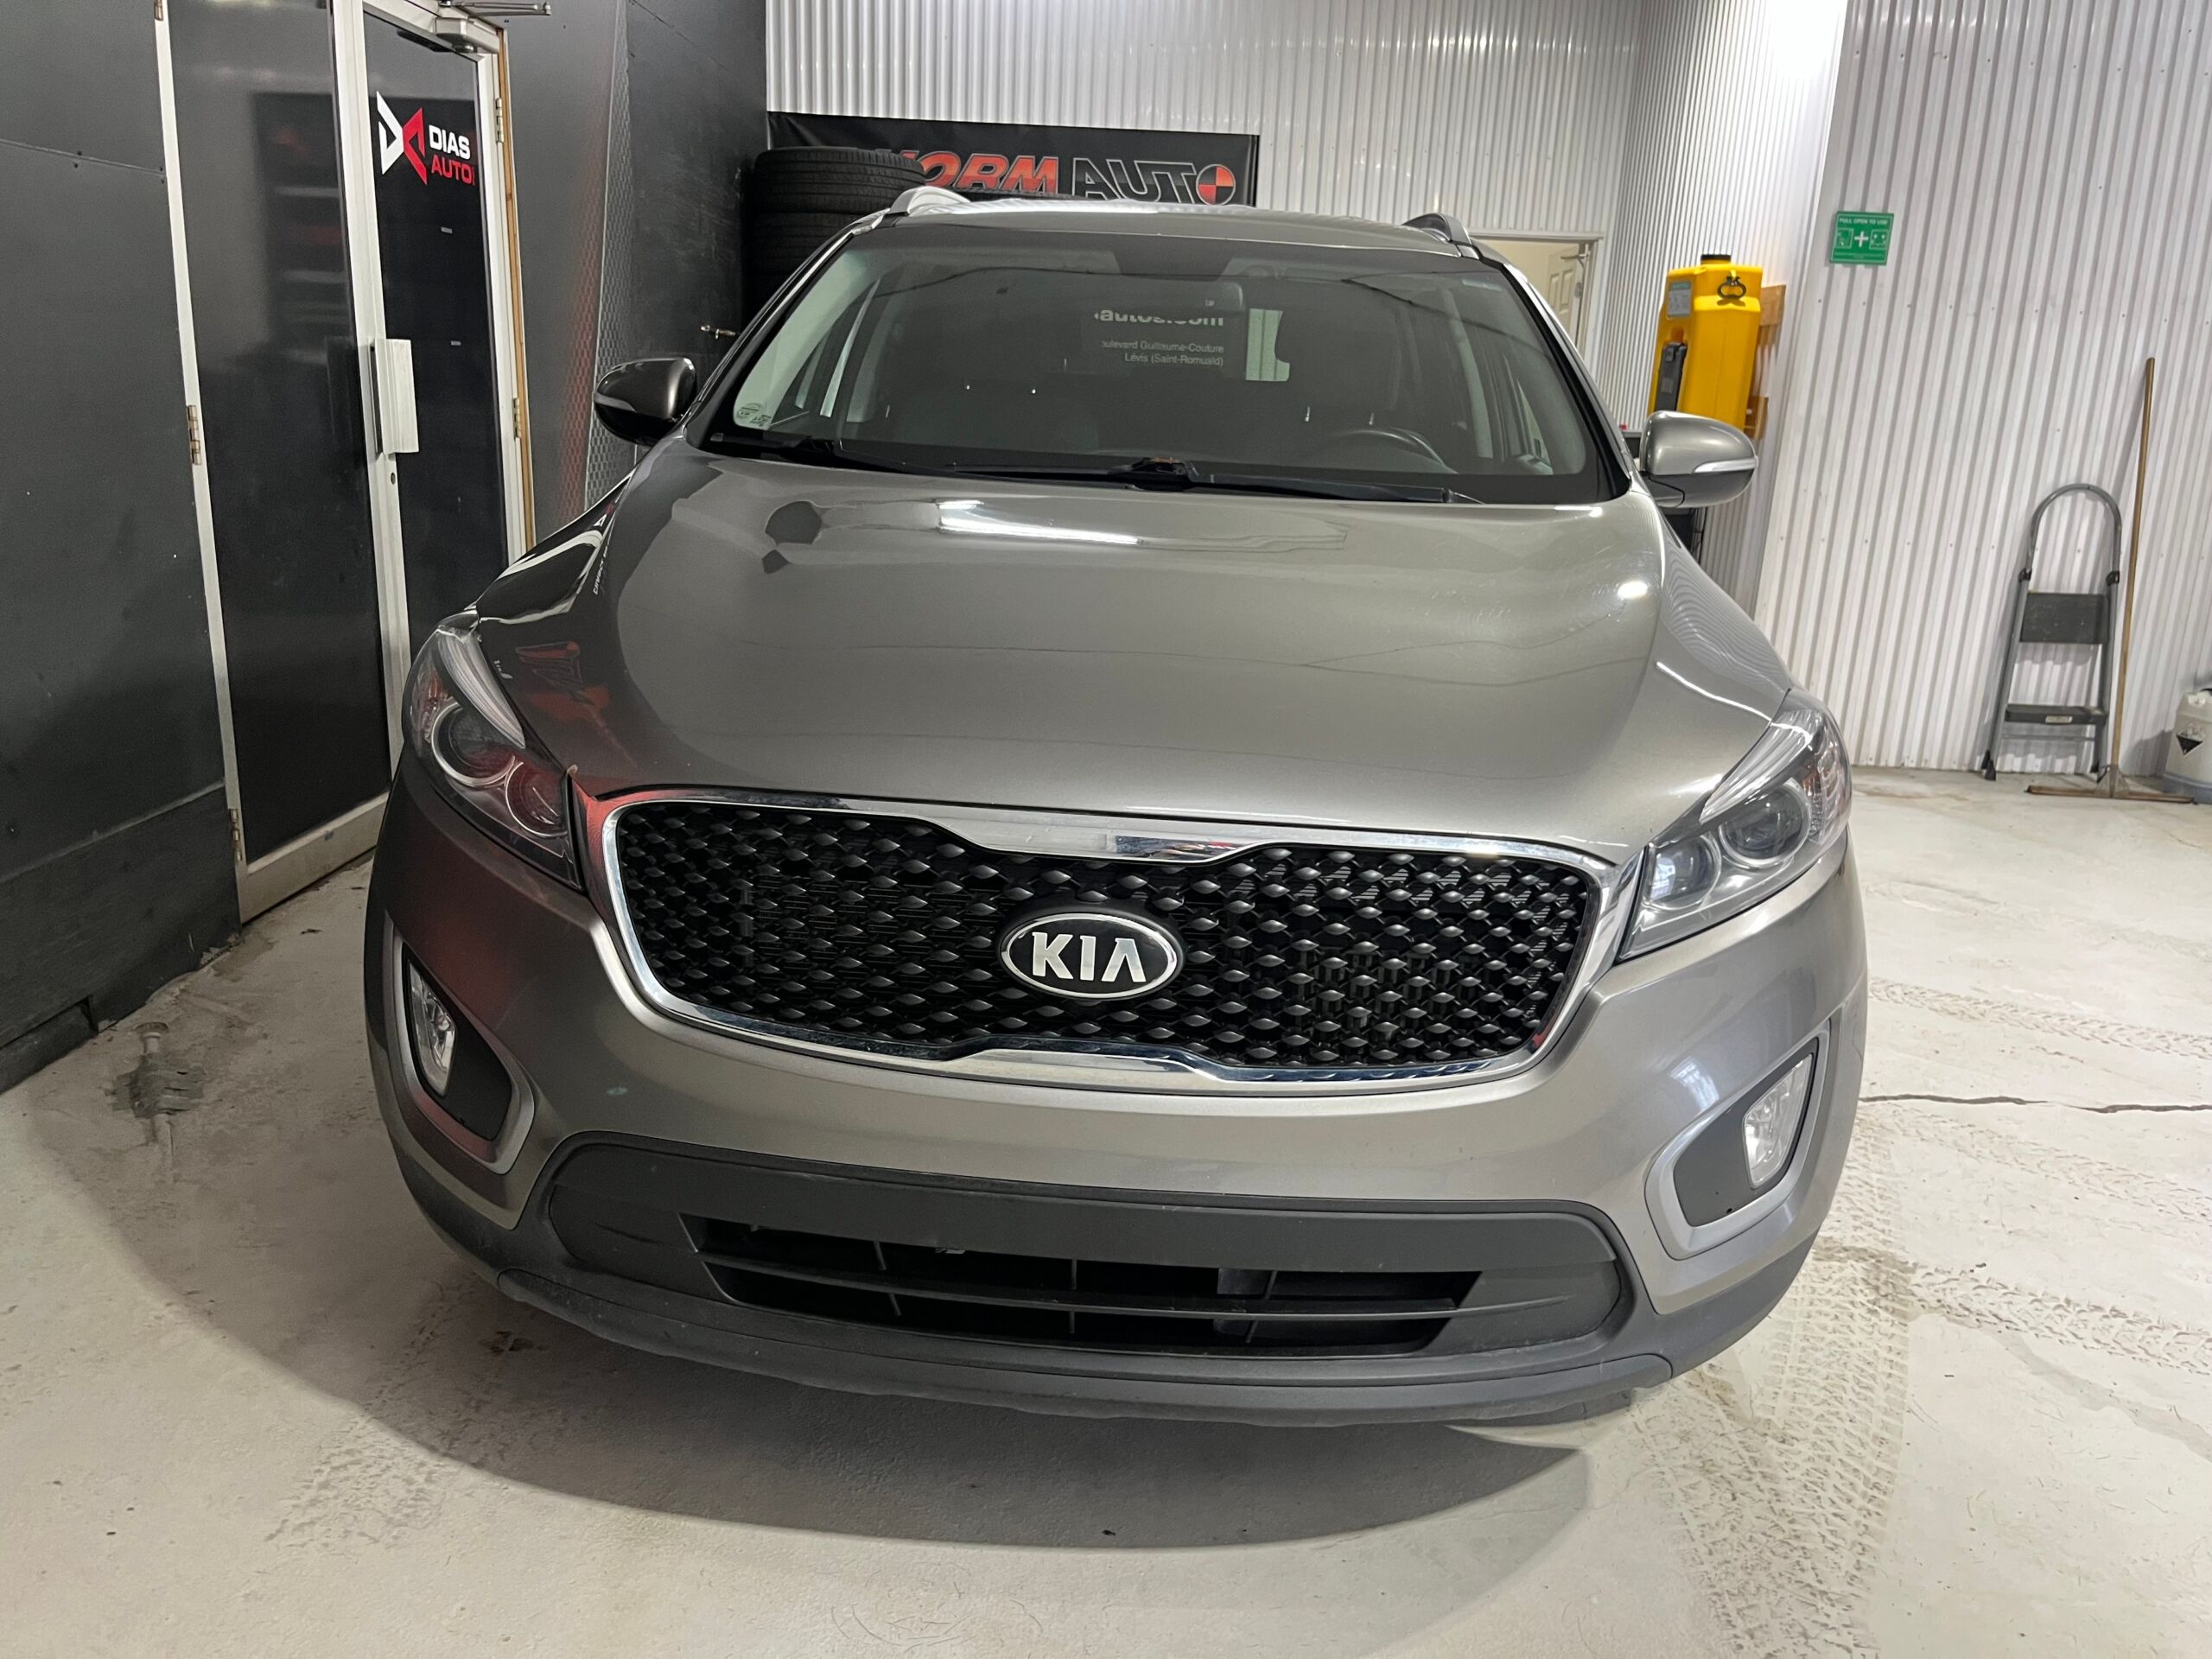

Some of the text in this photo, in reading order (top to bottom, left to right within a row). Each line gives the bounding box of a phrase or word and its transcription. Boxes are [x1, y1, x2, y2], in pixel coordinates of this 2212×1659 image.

[429, 124, 471, 160] DIAS
[431, 155, 475, 186] AUTO
[876, 149, 1237, 206] ORM AUTO
[1031, 931, 1147, 982] KIA
